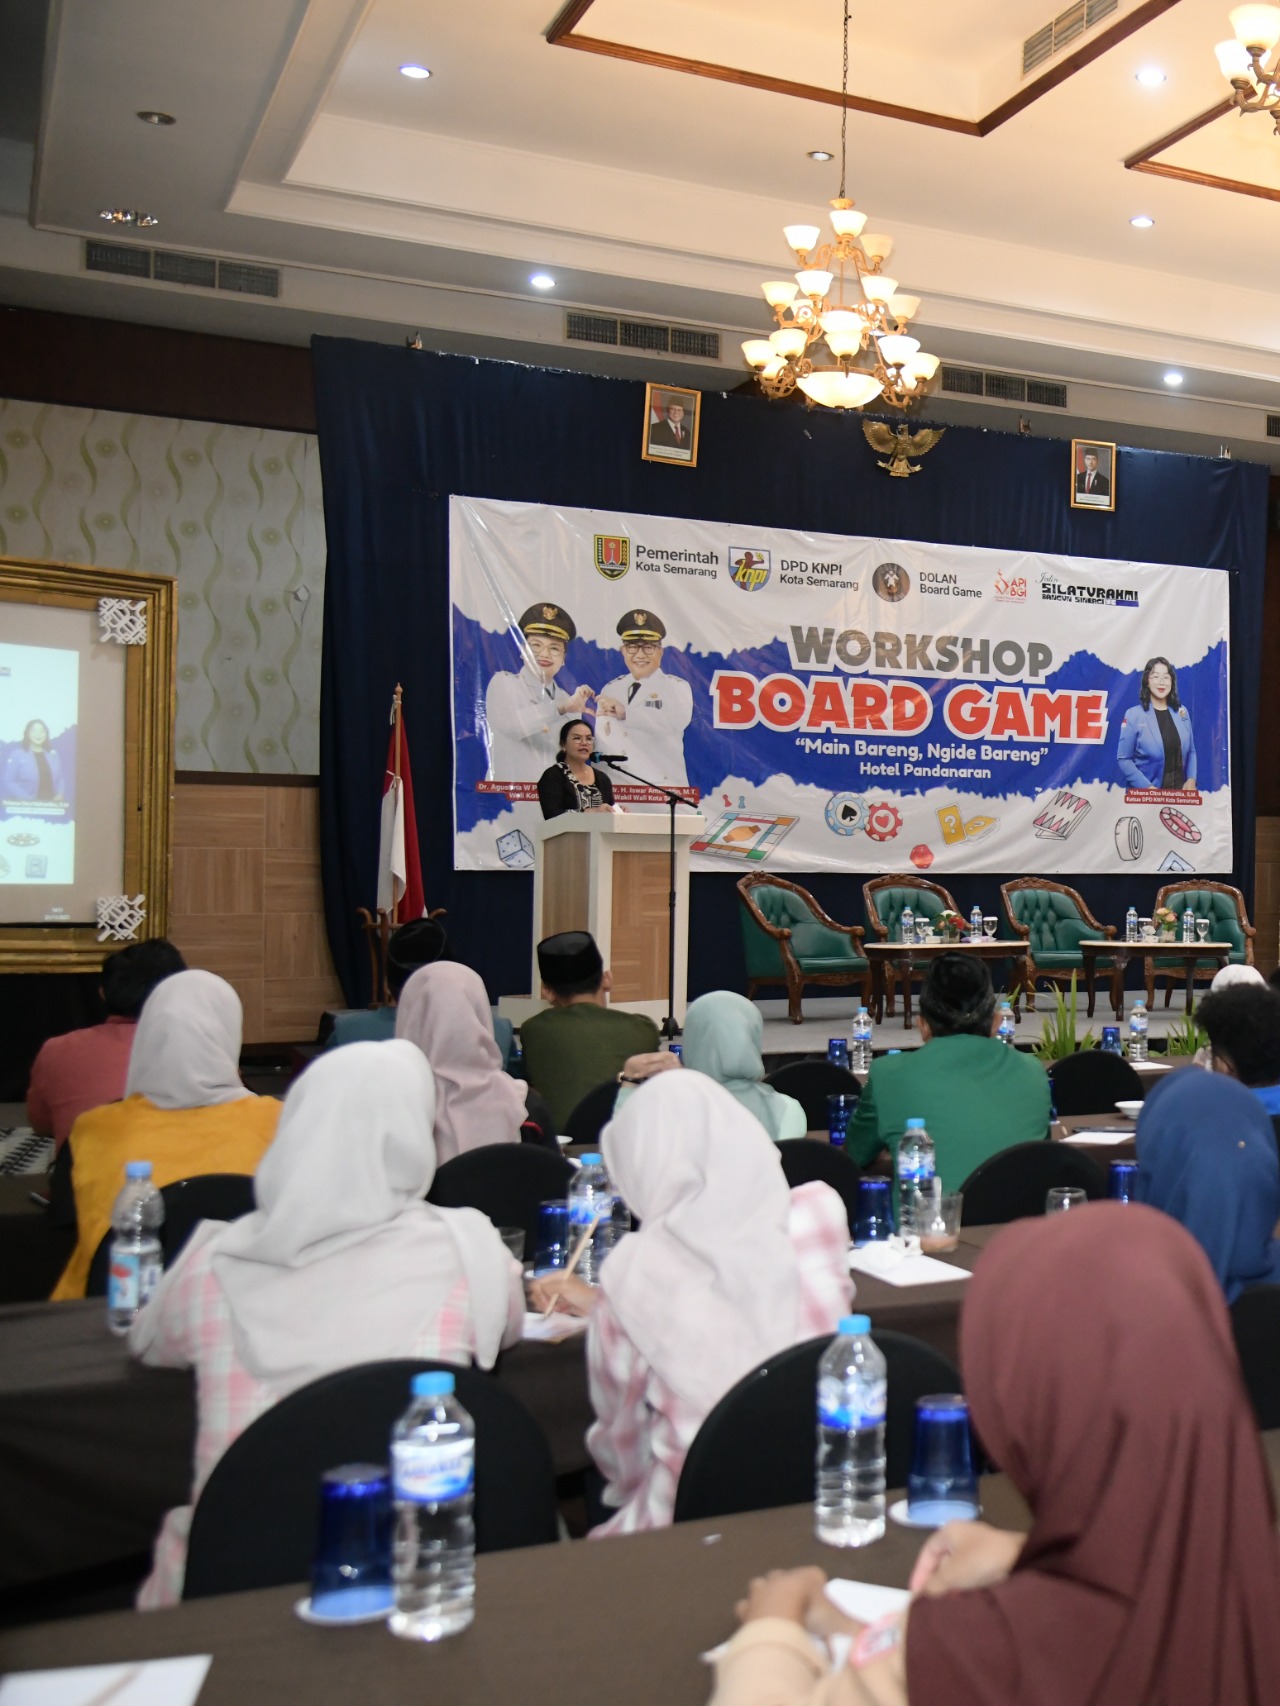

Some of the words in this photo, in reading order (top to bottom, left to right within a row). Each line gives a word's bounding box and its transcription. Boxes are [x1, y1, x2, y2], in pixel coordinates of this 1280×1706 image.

[636, 545, 719, 565] Pemerintah
[636, 561, 661, 573] Kota
[663, 564, 717, 579] Semarang
[781, 560, 808, 573] DPD
[812, 563, 842, 576] KNPI
[780, 574, 804, 585] Kota
[806, 576, 859, 591] Semarang
[920, 572, 957, 585] DOLAN
[1011, 578, 1027, 588] API
[920, 584, 949, 596] Board
[952, 587, 982, 598] Game
[1010, 588, 1027, 597] BGI
[790, 625, 1053, 678] WORKSHOP
[715, 675, 929, 732] BOARD
[948, 688, 1103, 740] GAME
[796, 738, 850, 756] “Main
[855, 740, 923, 761] Bareng,
[927, 742, 977, 764] Ngide
[981, 746, 1048, 766] Bareng”
[860, 762, 901, 777] Hotel
[904, 764, 991, 779] Pandanaran
[491, 784, 522, 792] Agustna
